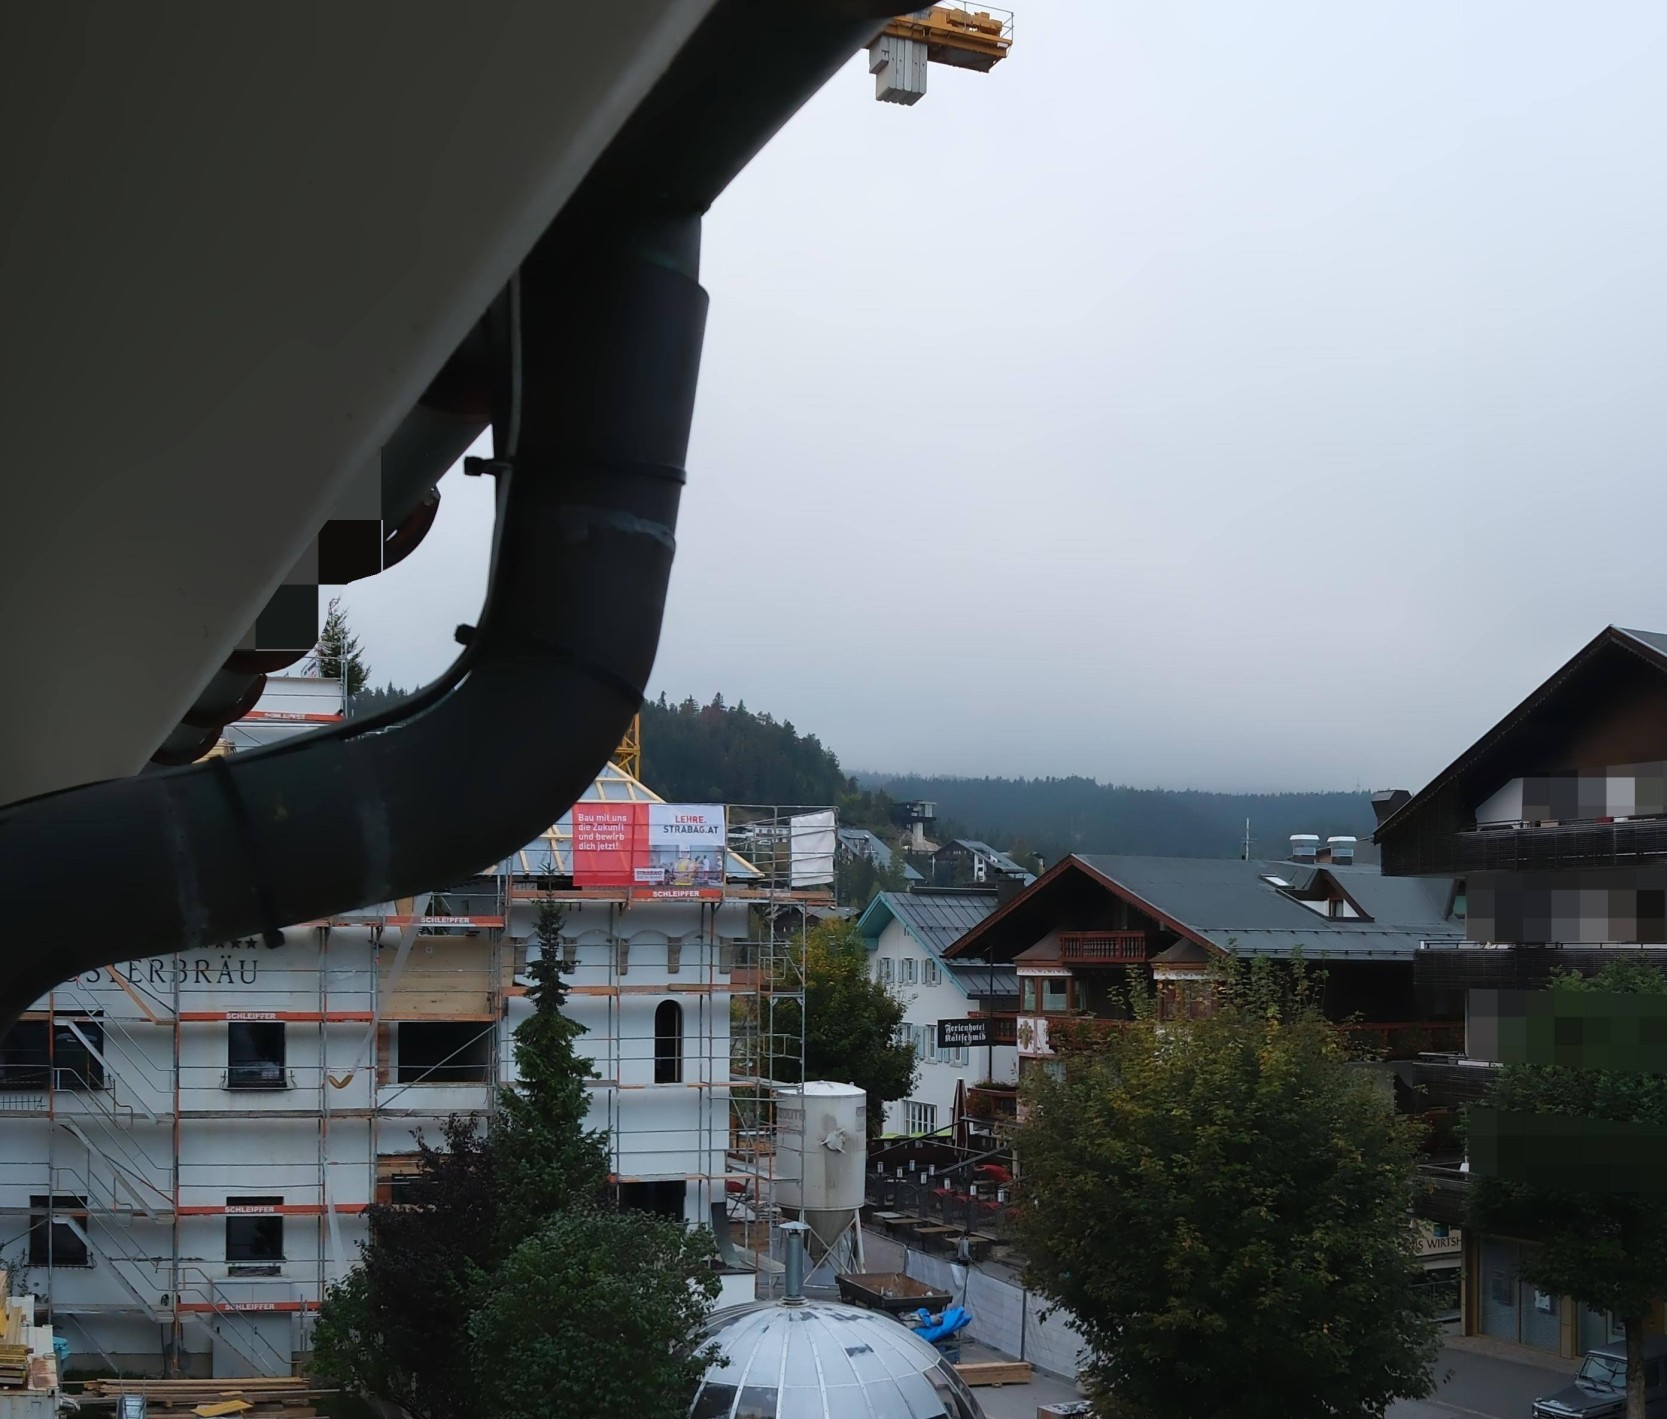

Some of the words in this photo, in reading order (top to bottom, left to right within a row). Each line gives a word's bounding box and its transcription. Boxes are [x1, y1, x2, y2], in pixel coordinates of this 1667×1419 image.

[578, 813, 594, 822] Bau
[596, 813, 610, 822] mit
[612, 814, 627, 822] uns
[675, 815, 707, 824] LEHRE.
[578, 823, 591, 831] die
[592, 823, 625, 831] Zukunft
[663, 824, 719, 834] STRABAG.AT
[578, 832, 594, 841] und
[595, 832, 625, 841] bewirb
[578, 841, 596, 850] dich
[597, 842, 619, 851] jetzt!
[652, 890, 700, 898] SCHLEIPFER
[225, 1012, 277, 1020] SCHLEIPFER
